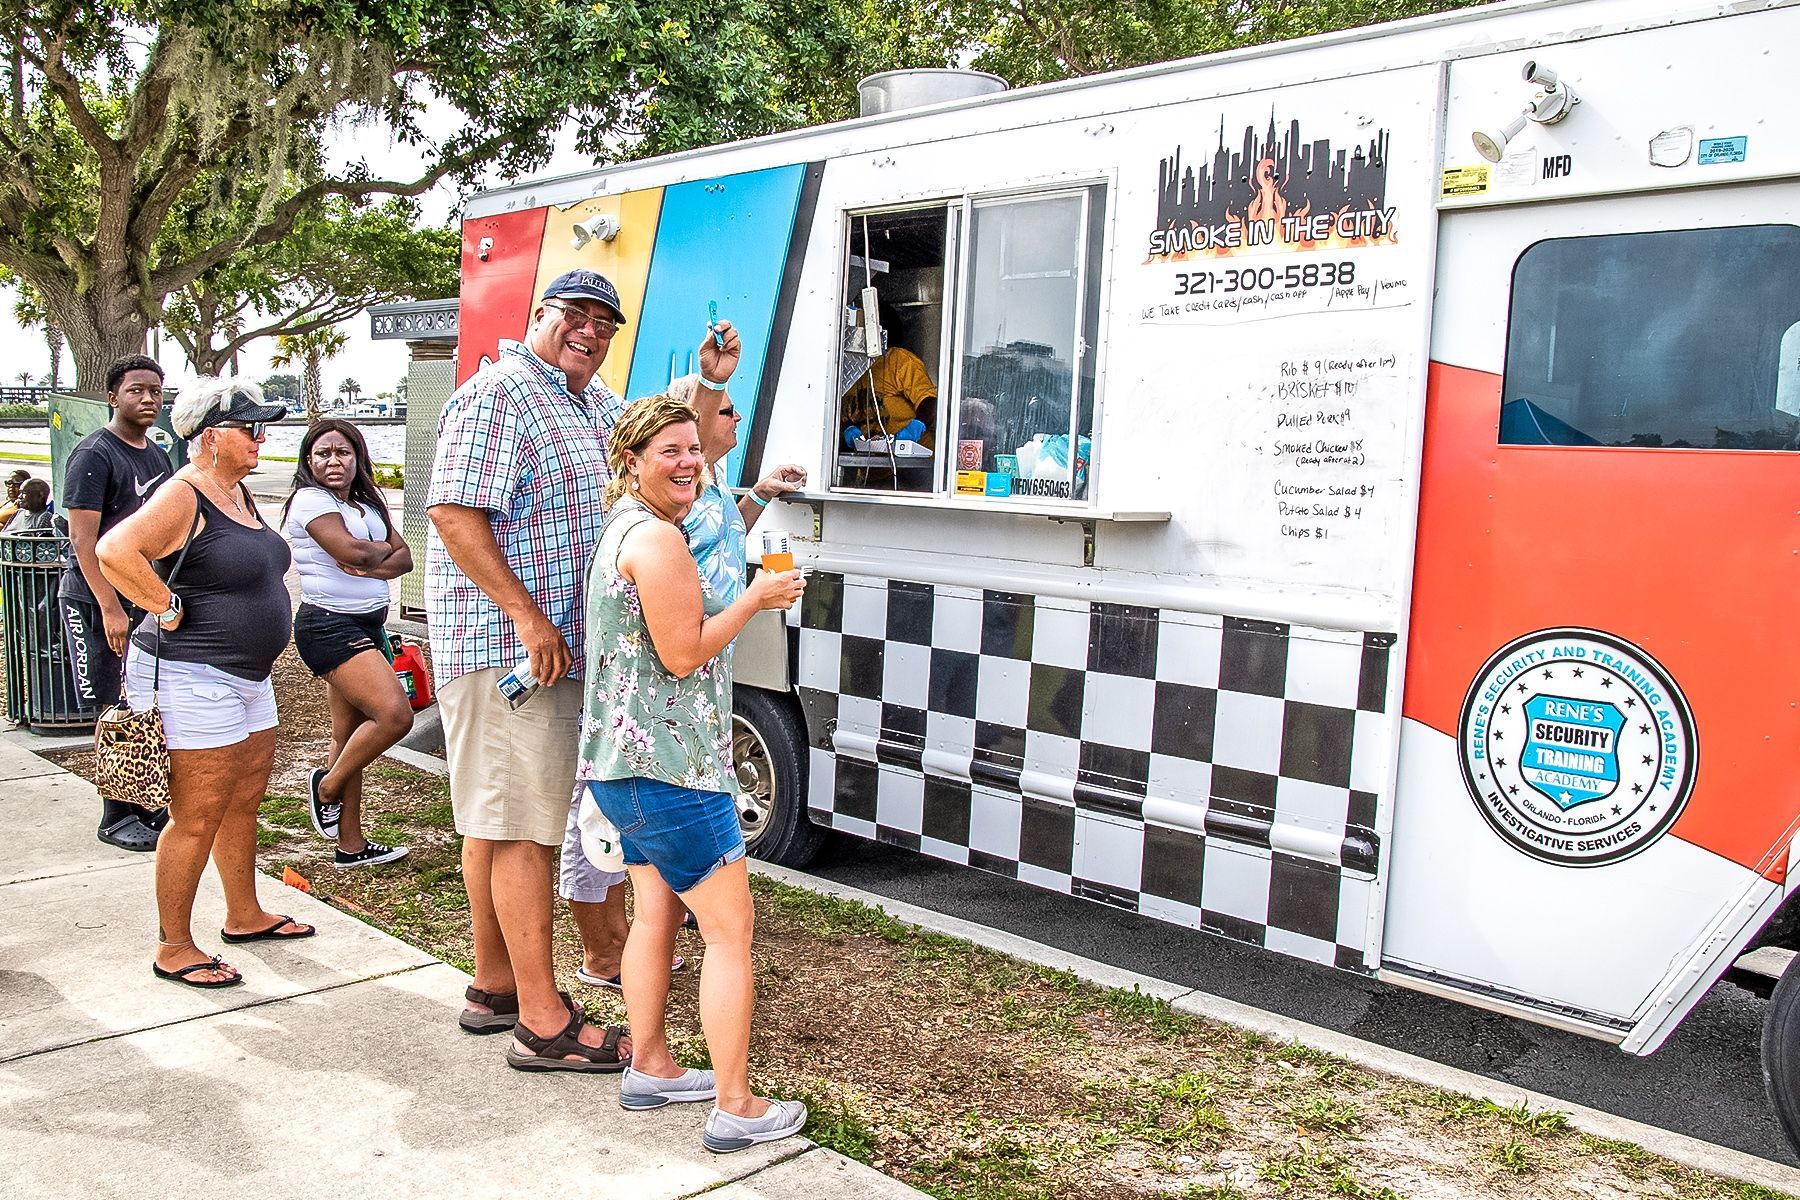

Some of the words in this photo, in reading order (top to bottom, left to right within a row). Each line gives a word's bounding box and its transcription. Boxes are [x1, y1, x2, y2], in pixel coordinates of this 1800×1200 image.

[1543, 155, 1571, 179] MFD
[1150, 222, 1241, 255] SMOKE
[1247, 218, 1274, 246] IN
[1282, 213, 1329, 243] THE
[1336, 207, 1396, 238] CITY
[1175, 261, 1355, 295] 321-300-5838
[1357, 285, 1370, 299] Pay
[1281, 361, 1297, 376] Rib
[1356, 359, 1377, 368] after
[1324, 456, 1344, 464] after
[1274, 480, 1325, 495] Cucumber
[1328, 486, 1357, 496] Salad
[1279, 501, 1309, 516] Potato
[1312, 503, 1340, 516] Salad
[1281, 524, 1310, 539] Chips
[66, 604, 84, 635] AIR
[73, 634, 96, 699] JORDAN
[1474, 704, 1489, 759] RENE'S
[1484, 649, 1545, 702] SECURITY
[1552, 646, 1587, 657] AND
[1593, 650, 1662, 706] TRAINING
[1656, 709, 1677, 791] ACADEMY
[1544, 700, 1605, 722] RENE'S
[1535, 723, 1609, 749] SECURITY
[1535, 747, 1605, 774] TRAINING
[1534, 770, 1602, 791] ACADEMY
[1487, 791, 1574, 850] INVESTIGATIVE
[1577, 821, 1642, 851] SERVICES
[1522, 799, 1561, 823] ORLANDO
[1567, 813, 1606, 826] FLORIDA
